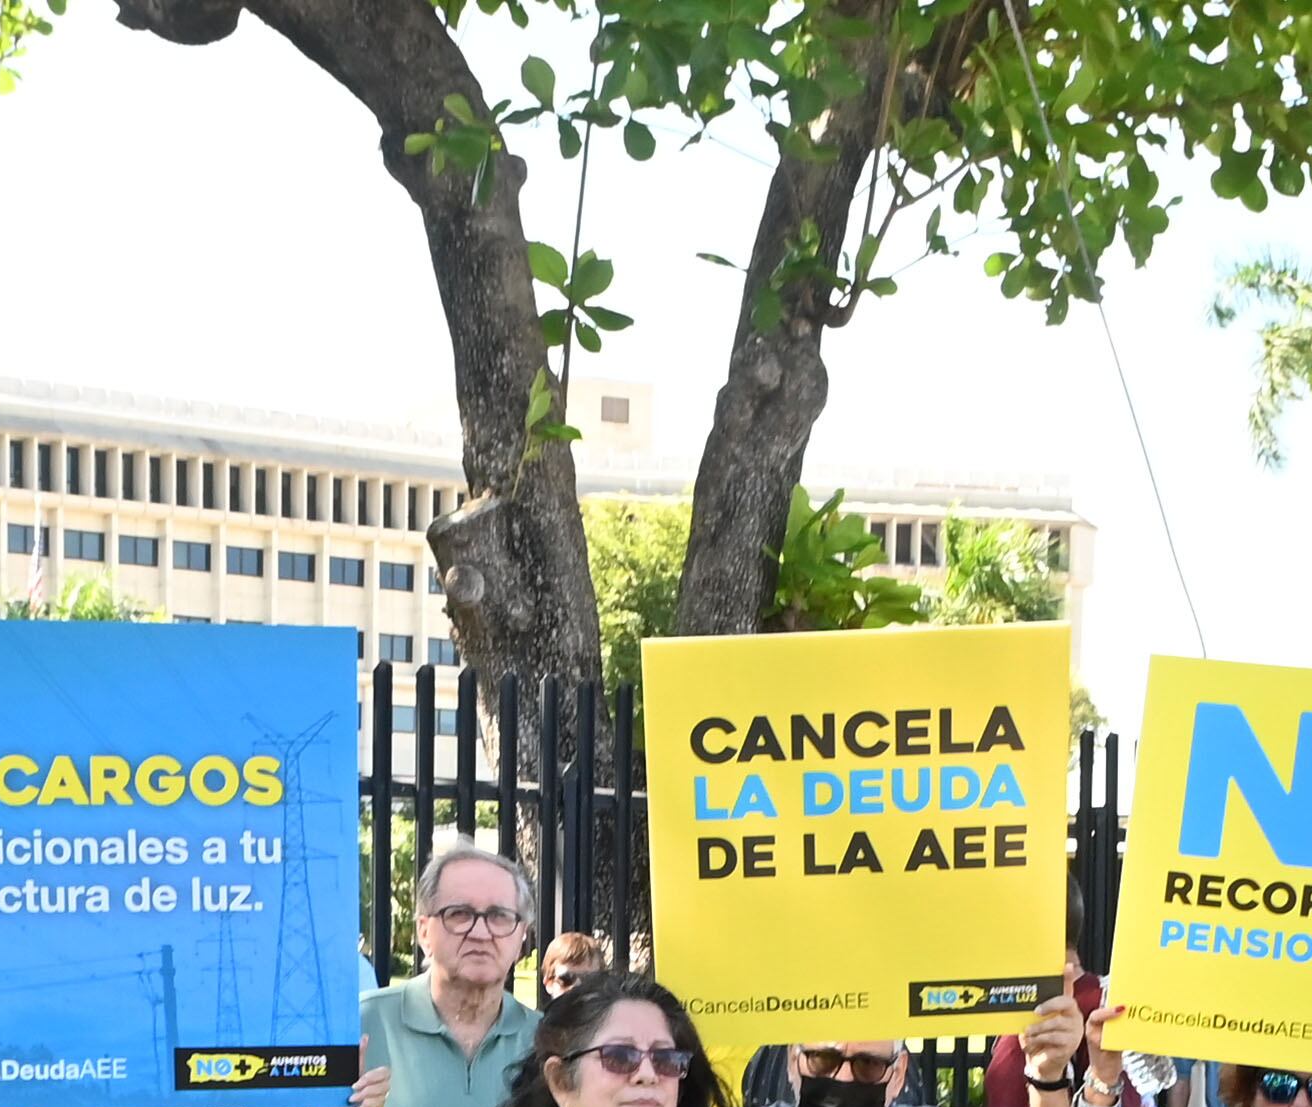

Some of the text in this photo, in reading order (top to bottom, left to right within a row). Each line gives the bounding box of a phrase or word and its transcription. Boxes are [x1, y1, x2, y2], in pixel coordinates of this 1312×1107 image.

[689, 705, 1026, 766] CANCELA
[692, 763, 1026, 821] LA DEUDA
[202, 839, 231, 866] a
[239, 832, 283, 865] tu
[696, 825, 1028, 881] DE LA AEE
[124, 877, 179, 913] de
[191, 877, 264, 913] luz.
[989, 992, 1037, 1004] A LA LUZ
[270, 1064, 326, 1076] A LA LUZ
